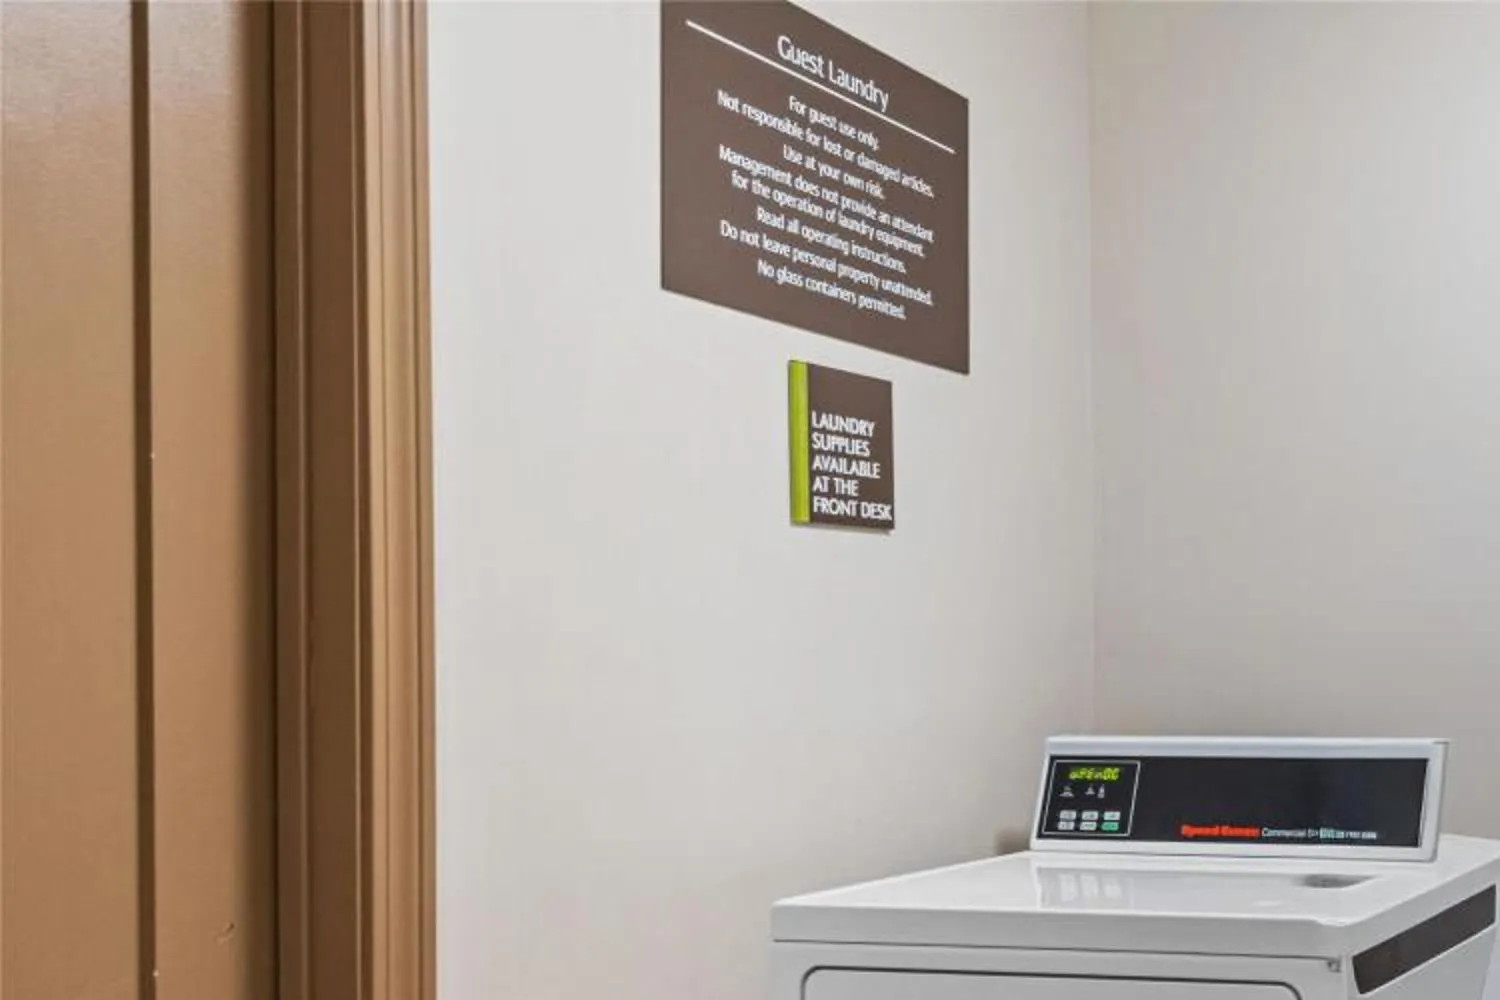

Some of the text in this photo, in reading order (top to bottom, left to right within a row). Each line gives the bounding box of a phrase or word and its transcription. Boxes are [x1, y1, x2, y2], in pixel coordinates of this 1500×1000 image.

[777, 35, 889, 112] Guest Laundry
[717, 89, 739, 113] Not
[742, 103, 804, 141] responsible
[805, 127, 820, 147] for
[823, 134, 842, 157] lost
[843, 147, 855, 162] or
[857, 151, 901, 183] damaged
[789, 95, 806, 116] For
[808, 107, 837, 131] guest
[838, 120, 857, 139] use
[783, 144, 803, 165] Use
[804, 156, 816, 171] at
[817, 161, 840, 180] your
[843, 172, 865, 191] own
[719, 143, 935, 244] Management does not provide an attendant
[731, 169, 749, 190] for
[751, 178, 771, 199] the
[772, 189, 824, 219] operation
[825, 207, 837, 223] of
[837, 208, 875, 241] laundry
[757, 205, 785, 230] Read
[785, 218, 800, 235] all
[801, 224, 849, 256] operating
[720, 219, 738, 240] Do
[740, 229, 760, 248] not
[762, 233, 791, 258] leave
[791, 247, 837, 273] personal
[837, 262, 880, 291] property
[757, 258, 775, 278] No
[776, 265, 804, 285] glass
[805, 277, 857, 305] containers
[812, 410, 875, 437] LAUNDRY
[812, 432, 871, 457] SUPPLIES
[812, 454, 880, 479] AVAILABLE
[812, 476, 859, 497] AT THE
[813, 495, 893, 521] FRONT DESK
